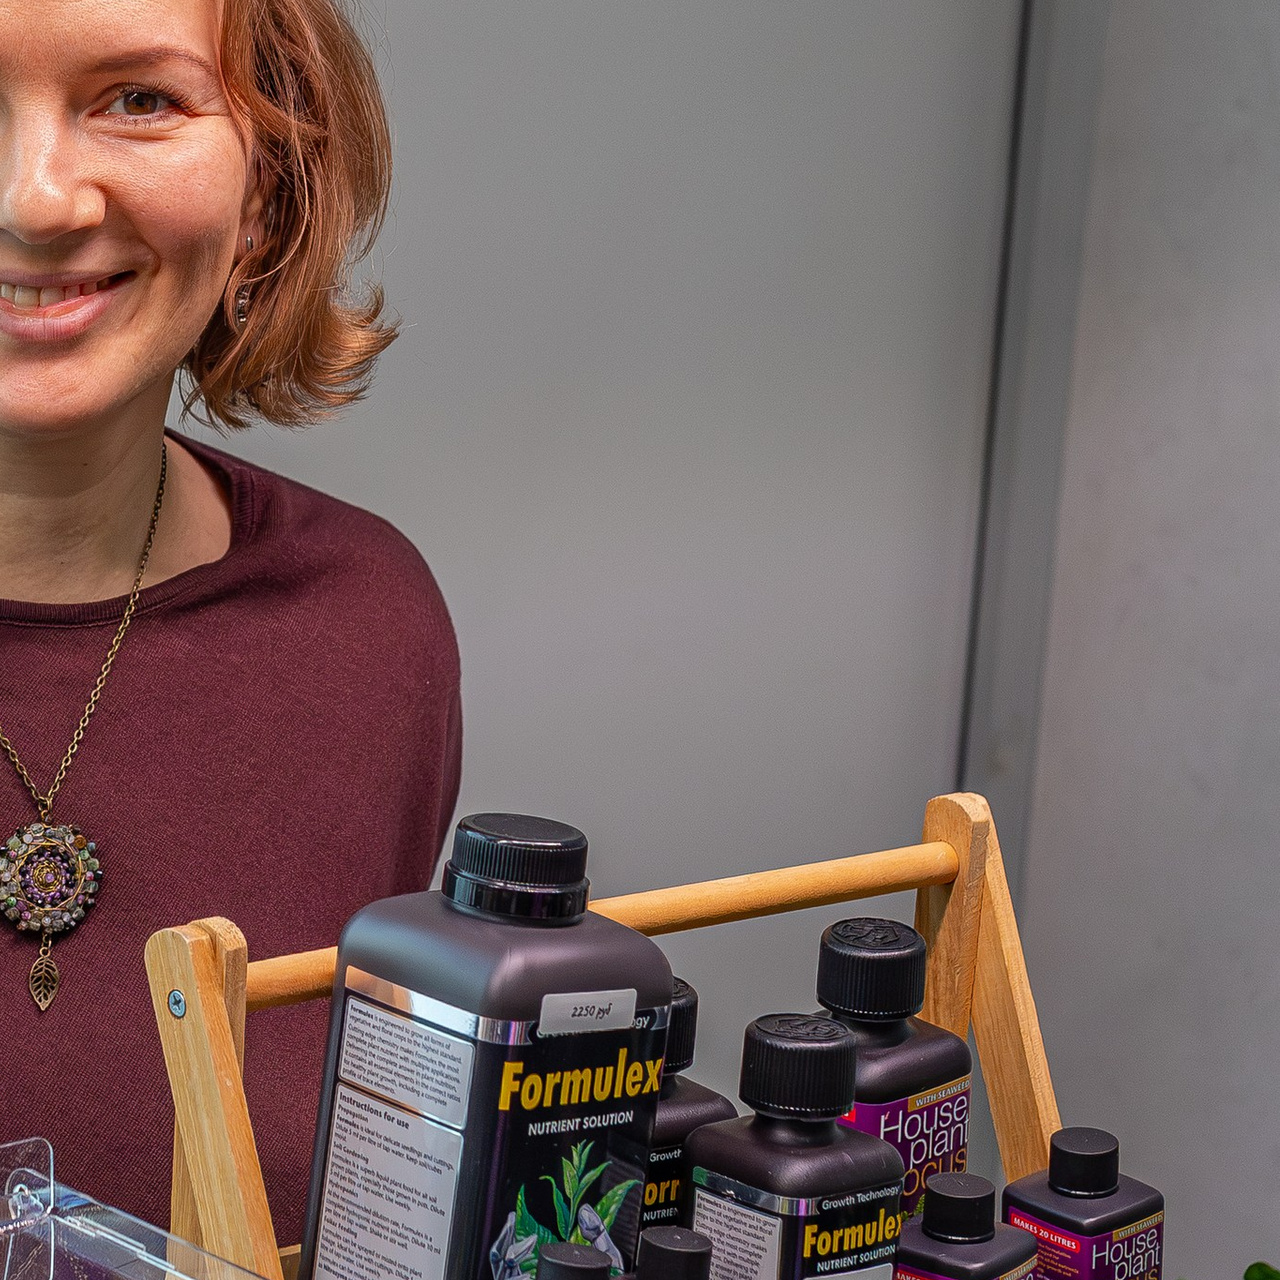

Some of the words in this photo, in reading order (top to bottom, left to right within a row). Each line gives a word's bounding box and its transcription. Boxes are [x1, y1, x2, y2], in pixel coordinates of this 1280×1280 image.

[572, 1005, 595, 1018] 2250
[595, 1003, 612, 1020] руб
[498, 1047, 663, 1111] Formulex
[915, 1094, 936, 1107] WITH
[937, 1080, 970, 1099] SEAWEED
[339, 1091, 382, 1117] Instructions
[383, 1110, 395, 1123] for
[396, 1117, 409, 1129] use
[528, 1118, 581, 1136] NUTRIENT
[582, 1110, 634, 1129] SOLUTION
[880, 1095, 968, 1143] House
[910, 1113, 969, 1170] plant
[903, 1148, 967, 1196] ocus
[822, 1196, 855, 1210] Growth
[856, 1185, 900, 1203] Technology
[803, 1208, 902, 1258] Formulex
[1013, 1217, 1037, 1233] MAKES
[1039, 1230, 1049, 1239] 20
[1050, 1234, 1076, 1250] LITRES
[1092, 1228, 1158, 1269] House
[817, 1255, 858, 1272] NUTRIENT
[860, 1244, 896, 1262] SOLUTION
